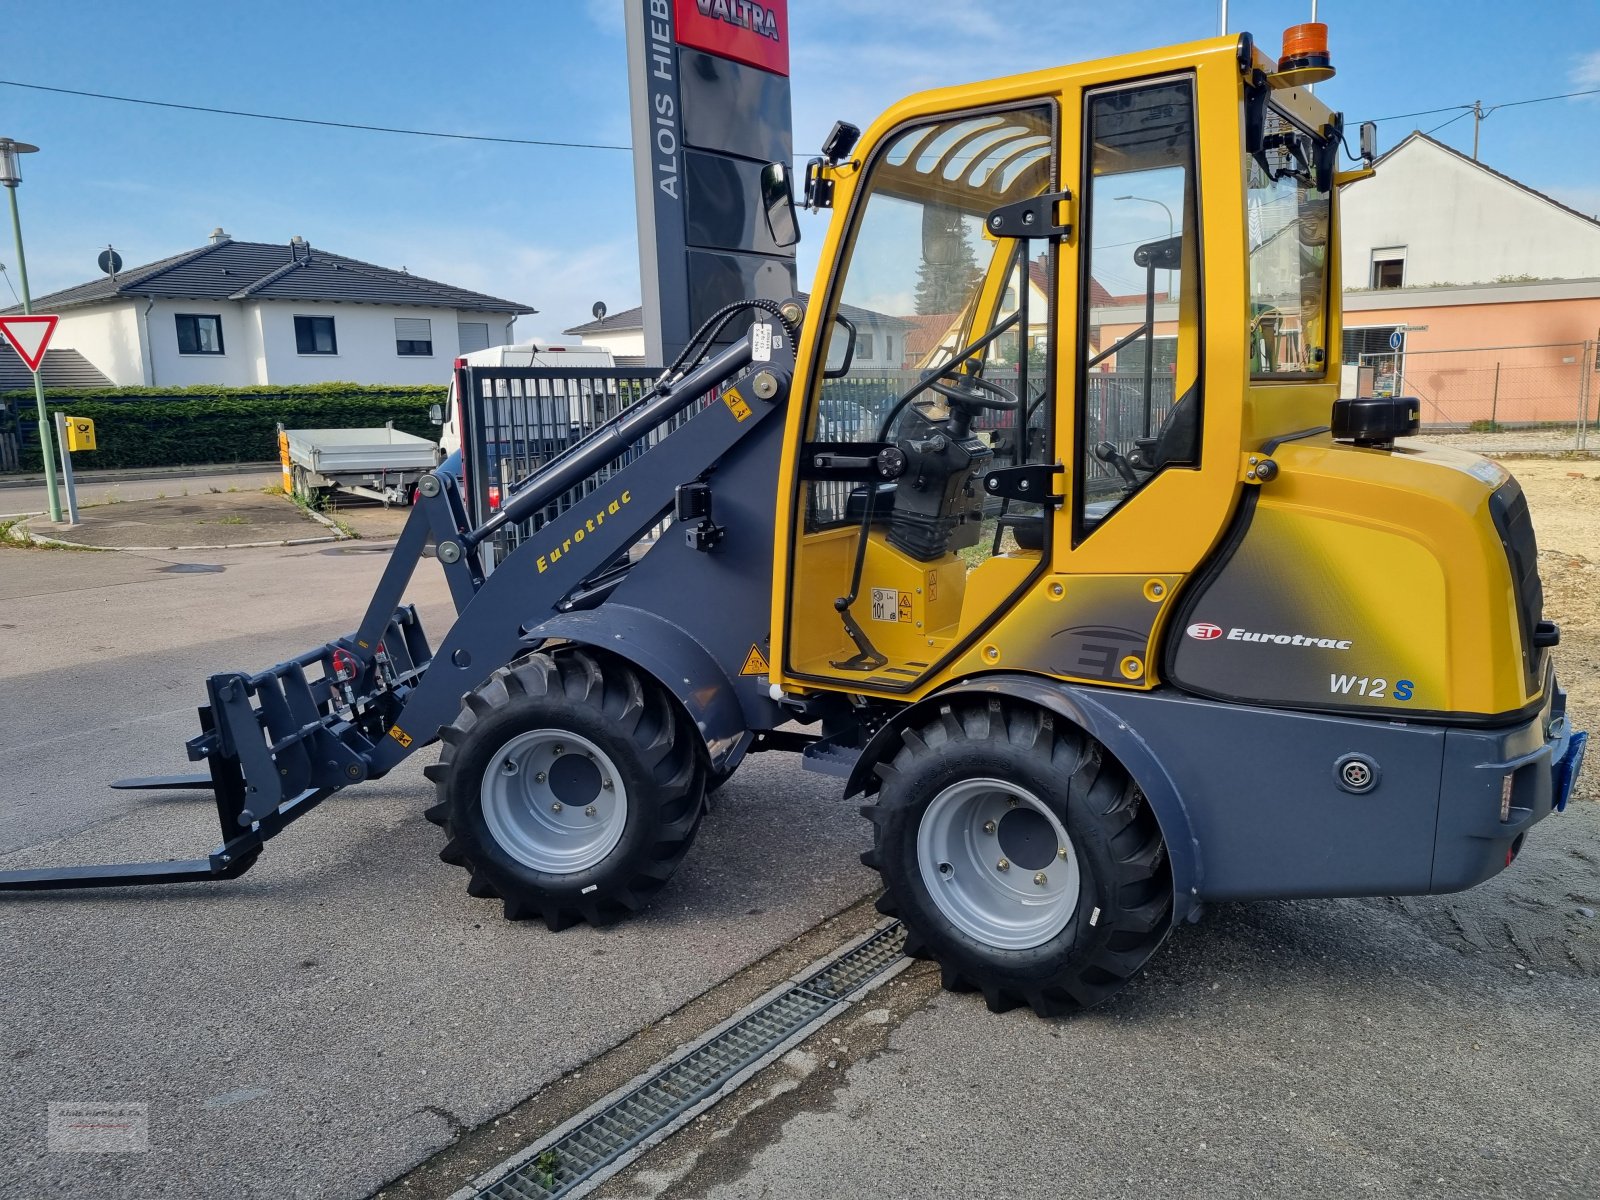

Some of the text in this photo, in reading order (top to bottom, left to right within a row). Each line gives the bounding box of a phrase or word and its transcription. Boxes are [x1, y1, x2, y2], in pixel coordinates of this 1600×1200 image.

[696, 0, 779, 41] VALTRA
[650, 0, 679, 200] ALOIS HIEB
[536, 490, 631, 574] Eurotrac
[873, 602, 885, 618] 101
[1227, 627, 1353, 651] Eurotrac
[1329, 673, 1415, 702] W12 S
